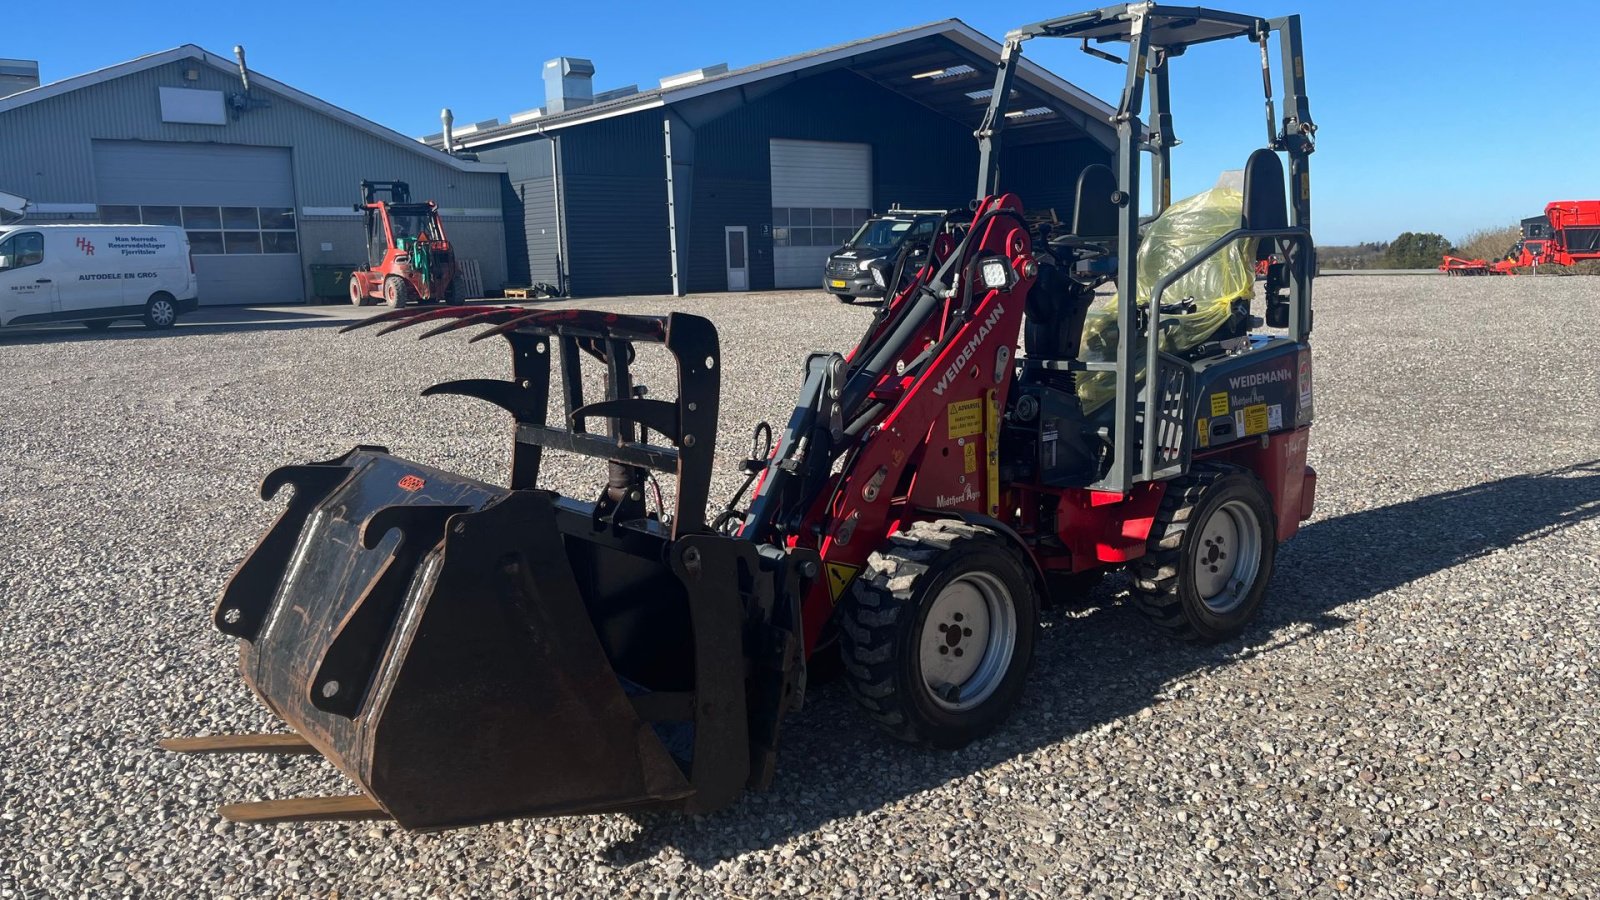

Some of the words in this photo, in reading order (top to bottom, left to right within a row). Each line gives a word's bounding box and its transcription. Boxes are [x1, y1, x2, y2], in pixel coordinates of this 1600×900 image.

[79, 273, 122, 281] AUTODELE
[137, 271, 158, 279] GROS
[334, 271, 344, 285] 7
[932, 303, 1005, 395] WEIDEMANN
[1229, 369, 1292, 389] WEIDEMANN
